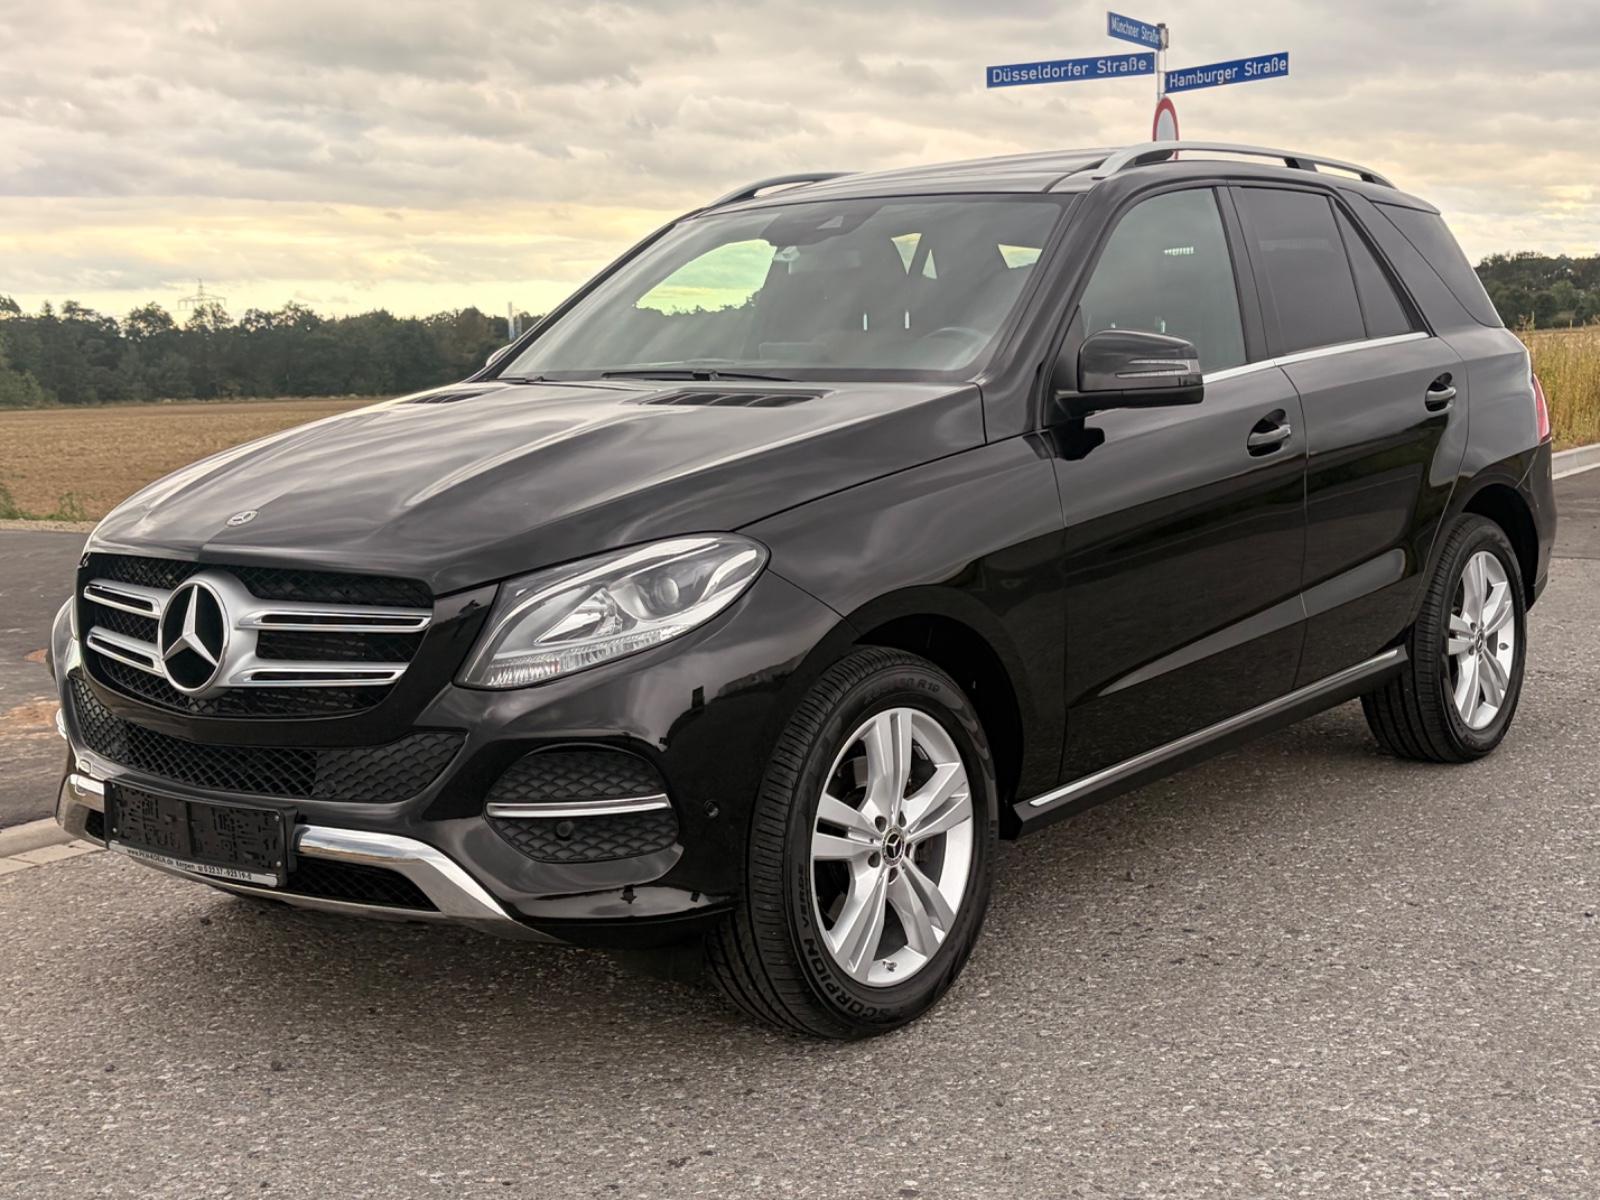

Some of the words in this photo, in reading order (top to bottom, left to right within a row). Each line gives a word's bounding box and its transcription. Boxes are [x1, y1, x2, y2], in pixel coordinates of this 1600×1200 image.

[1111, 15, 1139, 38] Münchner
[992, 62, 1089, 83] Düsseldorfer
[1097, 57, 1147, 74] Straße
[1169, 66, 1238, 88] Hamburger
[1244, 57, 1286, 76] Straße
[803, 938, 893, 1018] SCORPION
